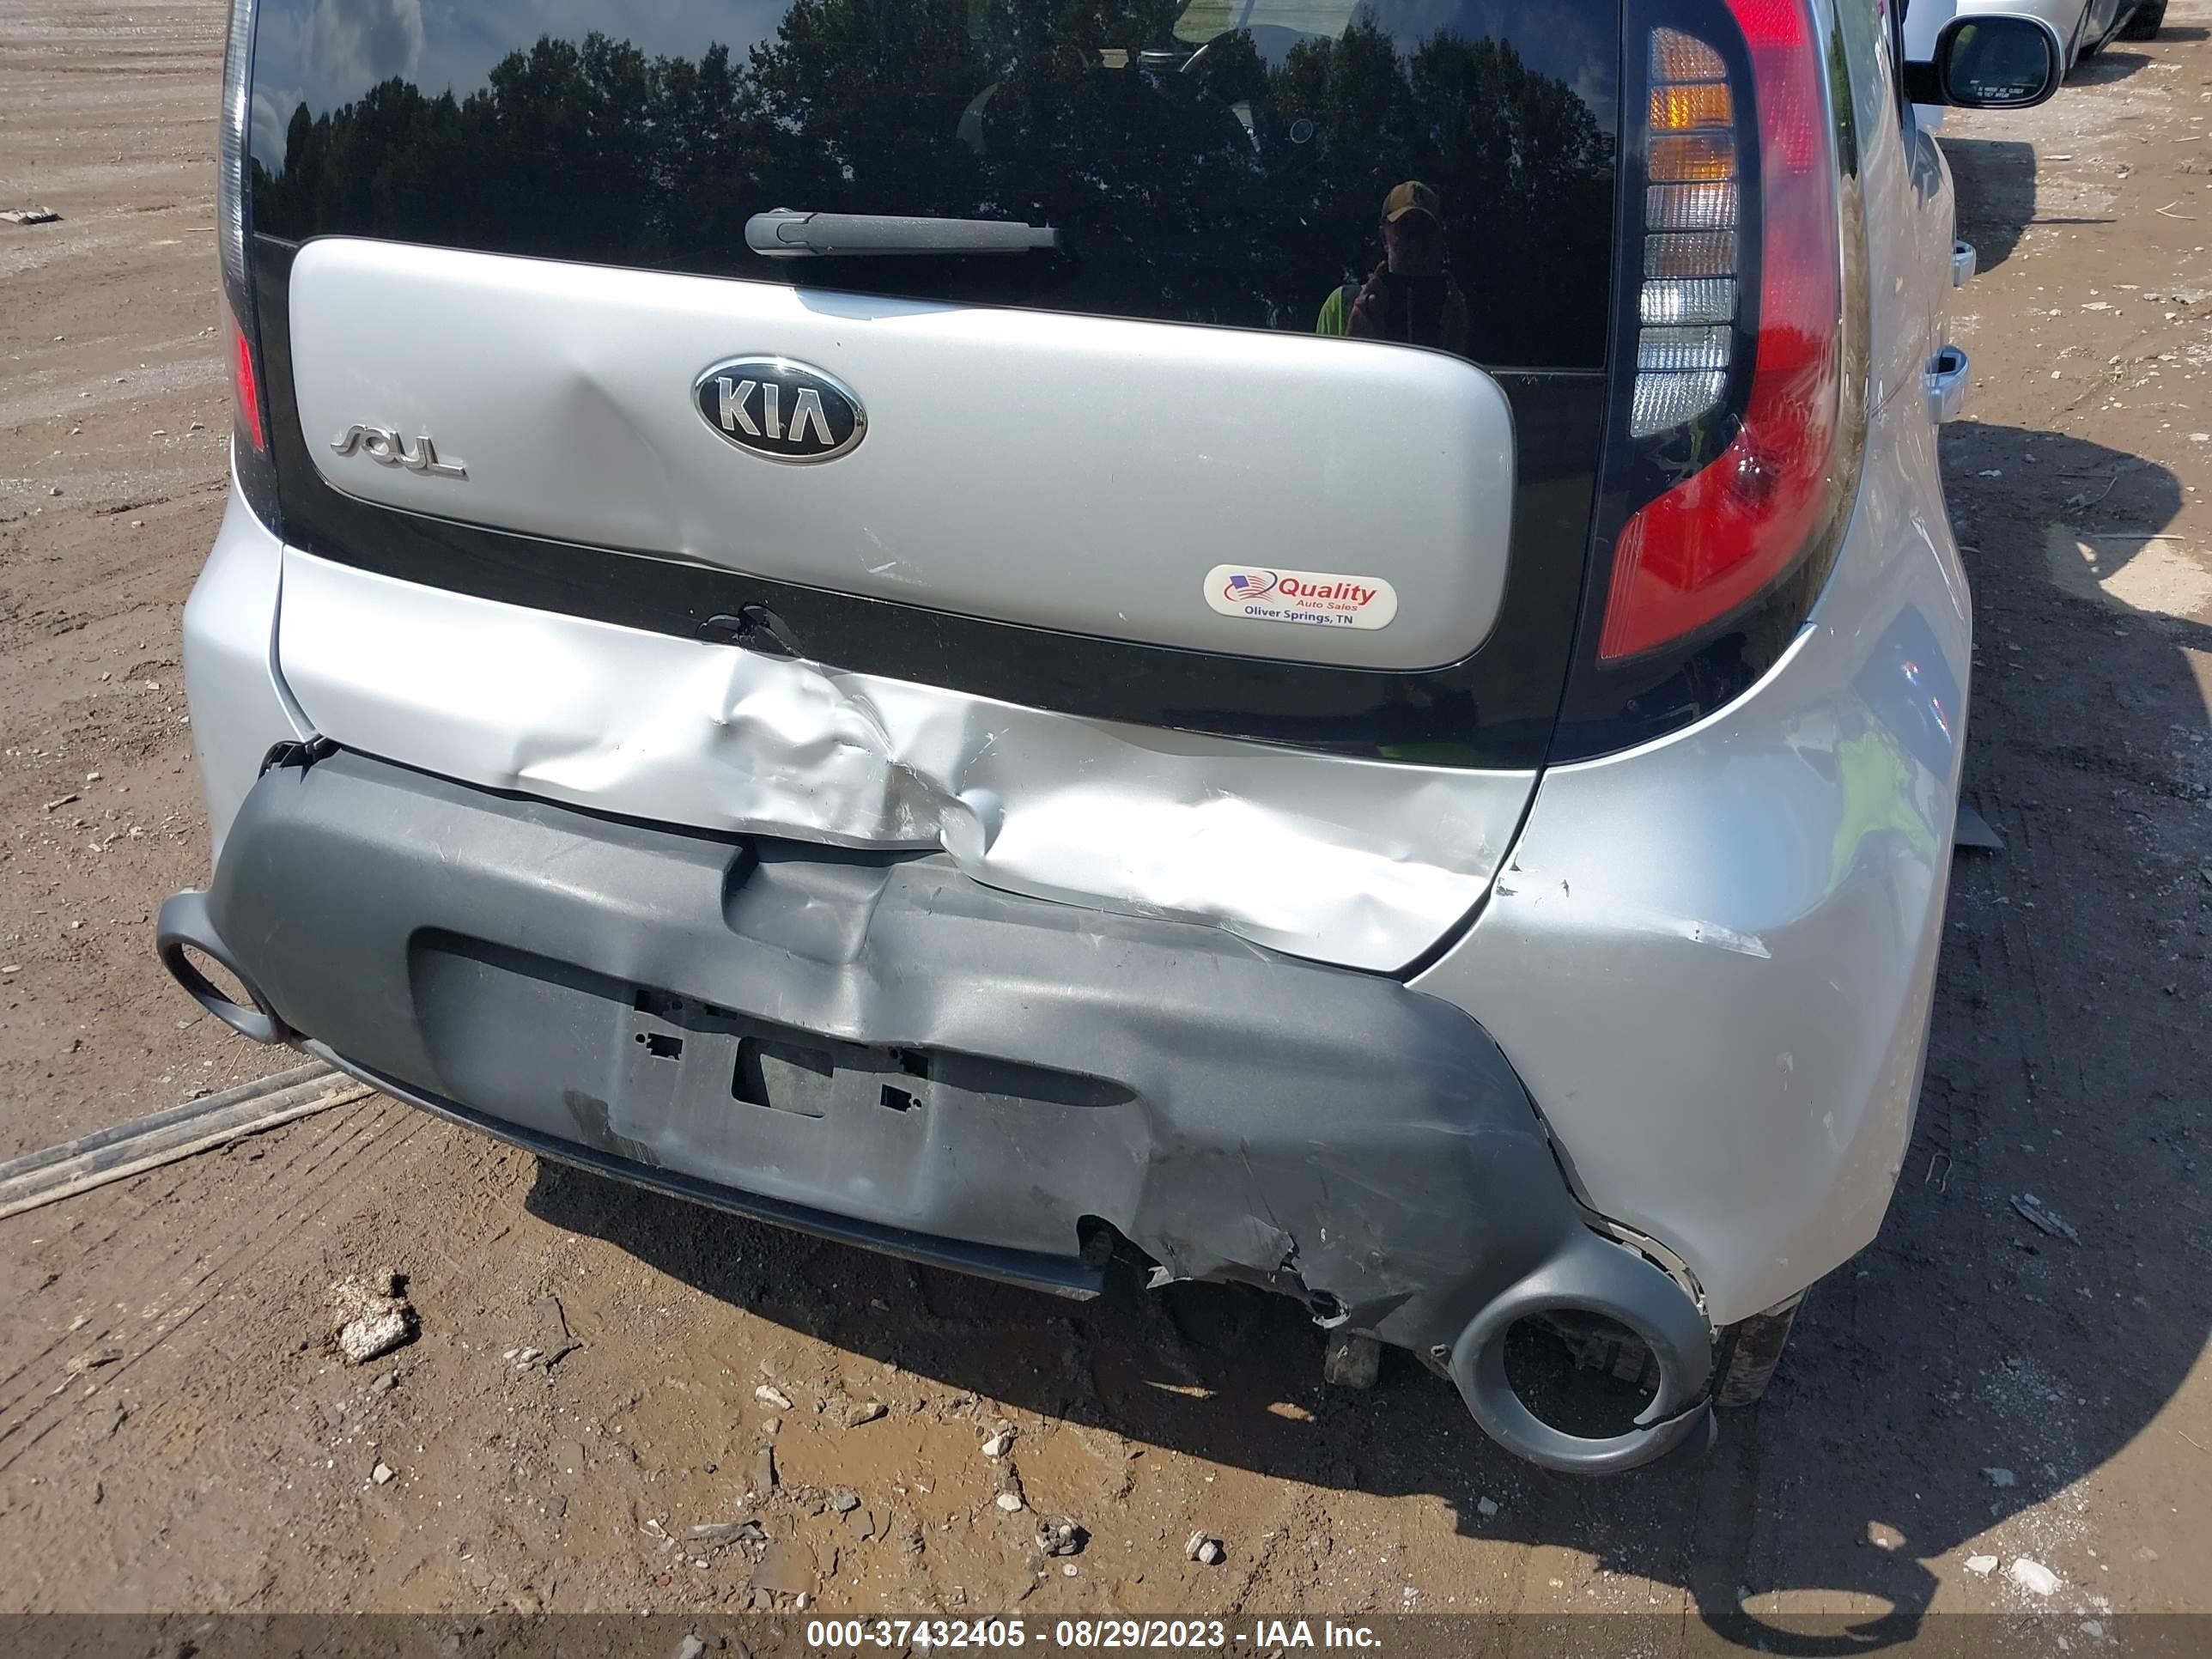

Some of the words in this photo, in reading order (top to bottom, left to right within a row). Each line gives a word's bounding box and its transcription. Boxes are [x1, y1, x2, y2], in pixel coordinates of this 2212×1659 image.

[716, 376, 836, 446] KIA
[331, 423, 470, 481] SOUL
[1279, 578, 1377, 605] Quality
[1296, 599, 1323, 609] Auto
[1327, 602, 1358, 611] Sales
[1244, 605, 1281, 617] Oliver
[1284, 610, 1333, 624] Springs,
[1336, 614, 1353, 624] TN
